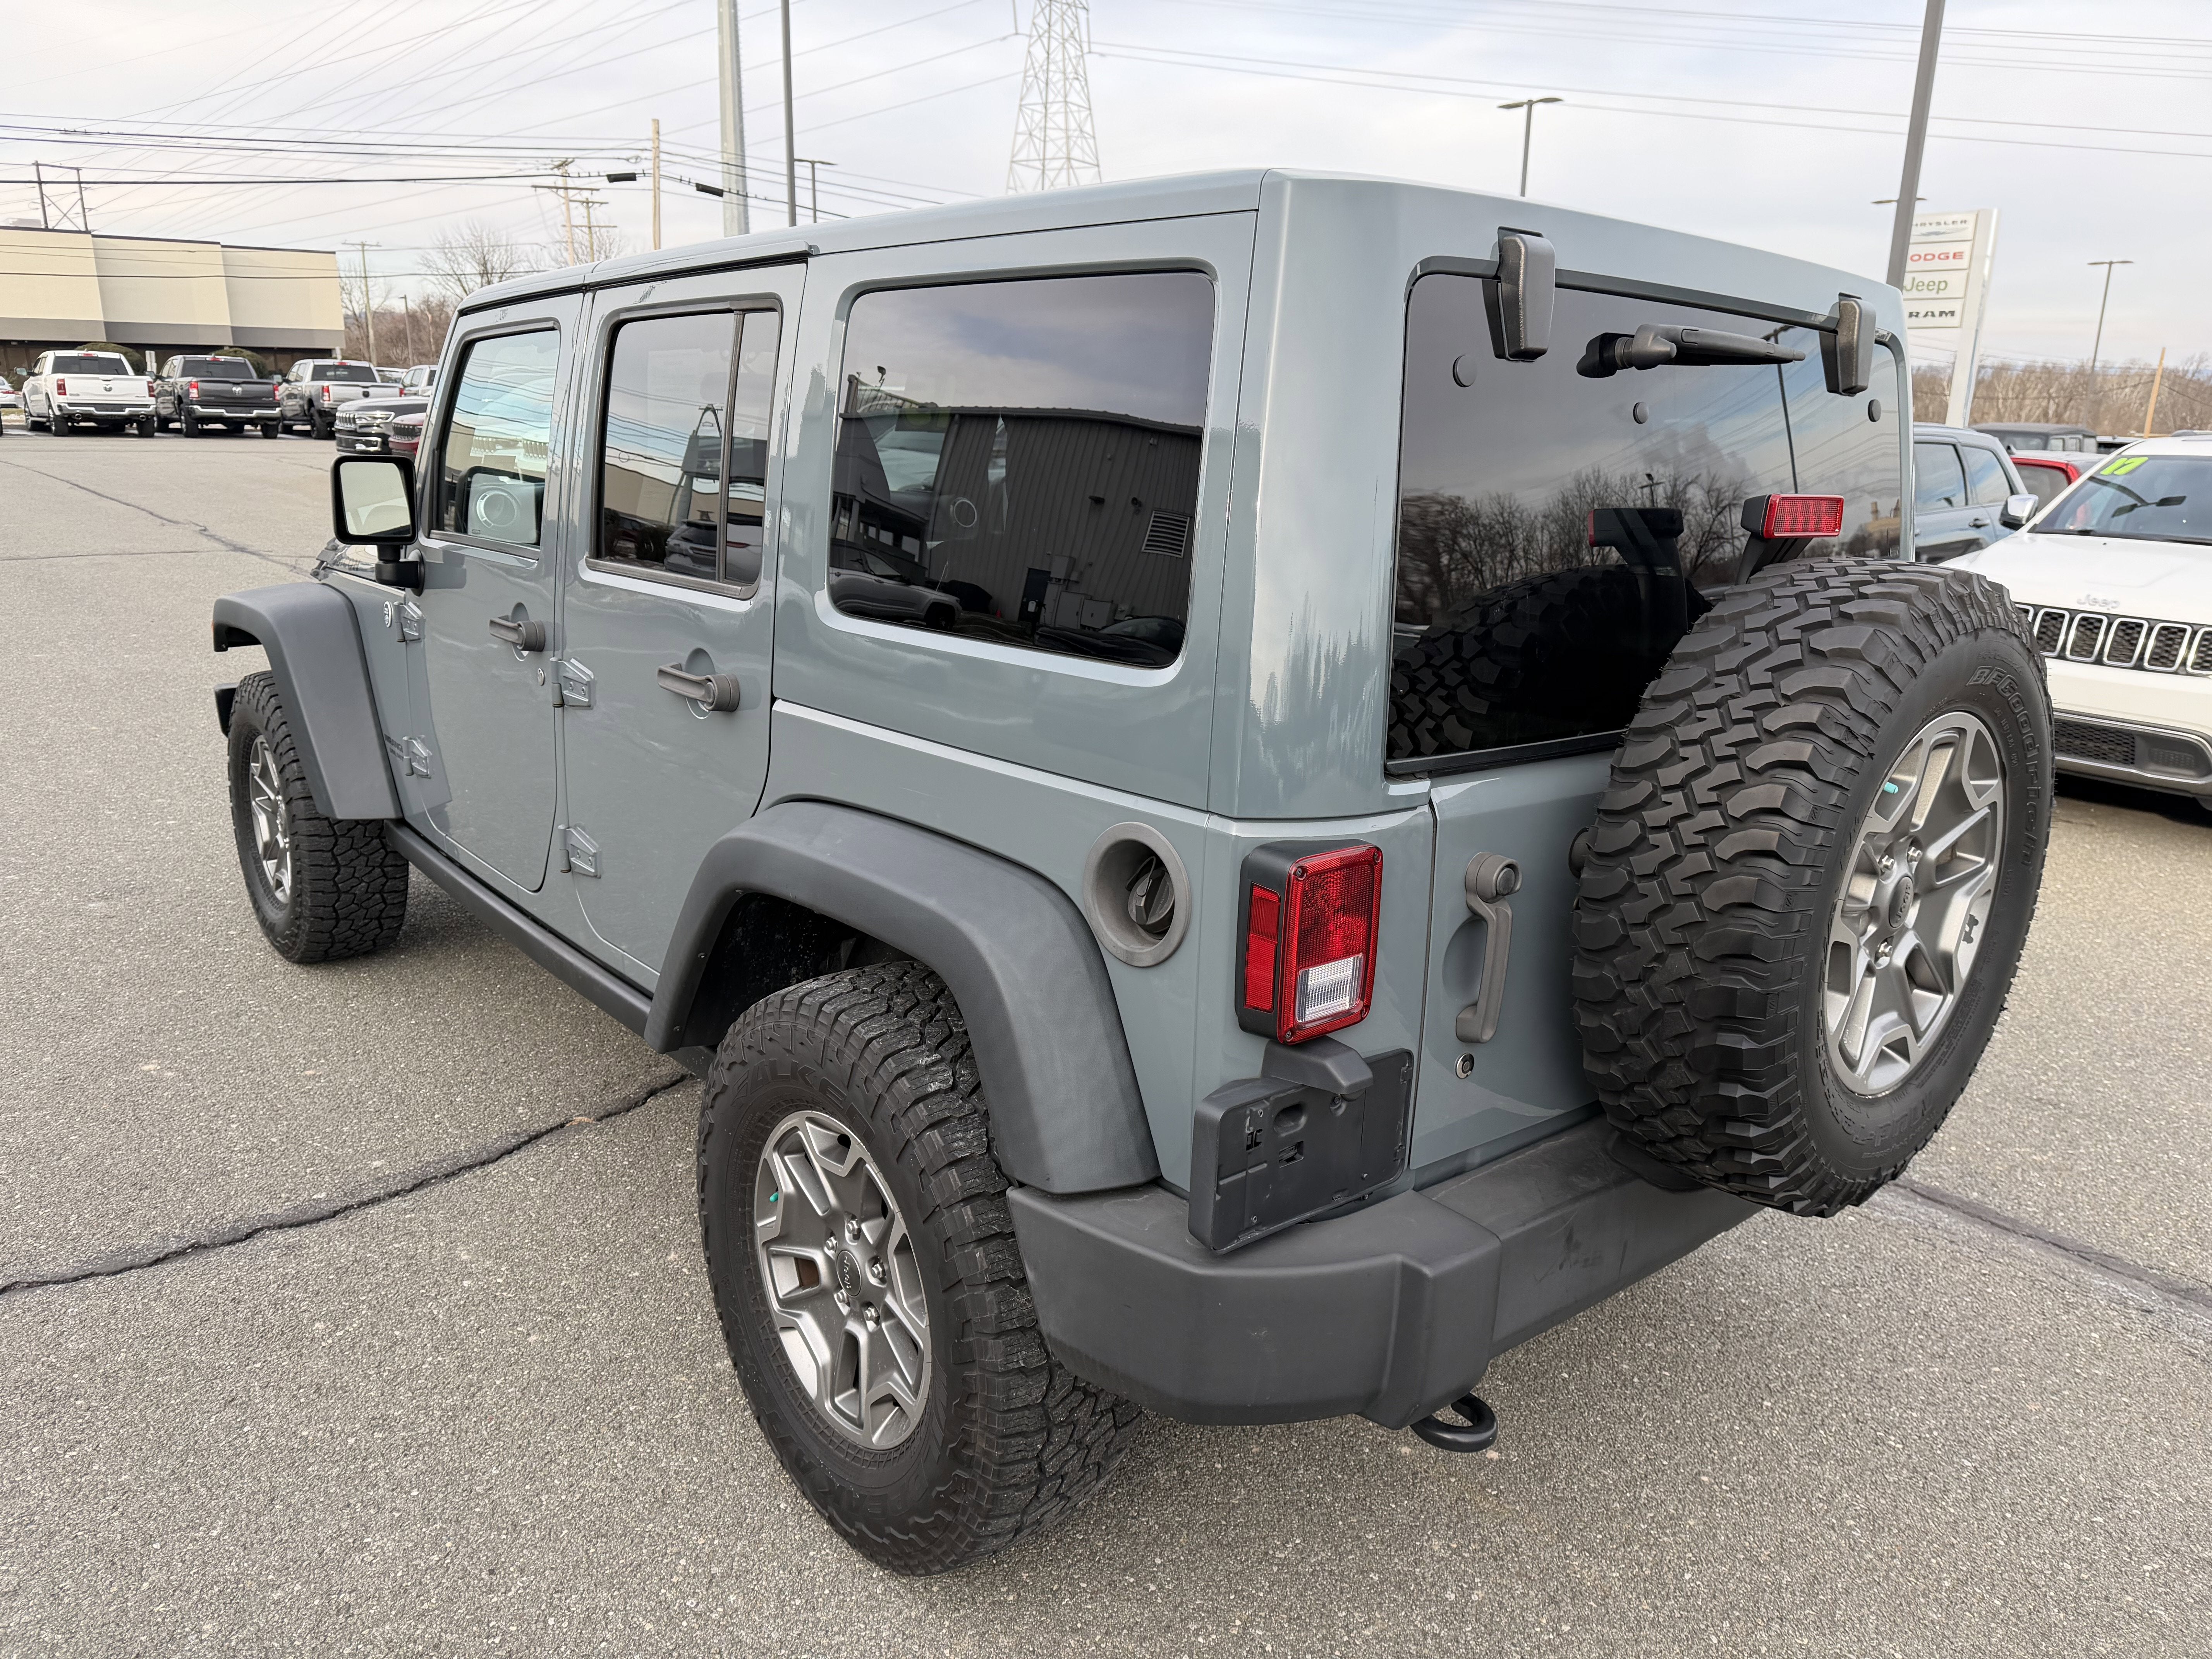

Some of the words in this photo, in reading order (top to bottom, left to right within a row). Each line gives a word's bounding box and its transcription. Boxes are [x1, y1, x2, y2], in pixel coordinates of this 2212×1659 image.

[1910, 251, 1965, 262] ODGE
[1903, 277, 1948, 294] Jeep
[2076, 594, 2120, 611] Jeep
[730, 1058, 875, 1145] FALKEN
